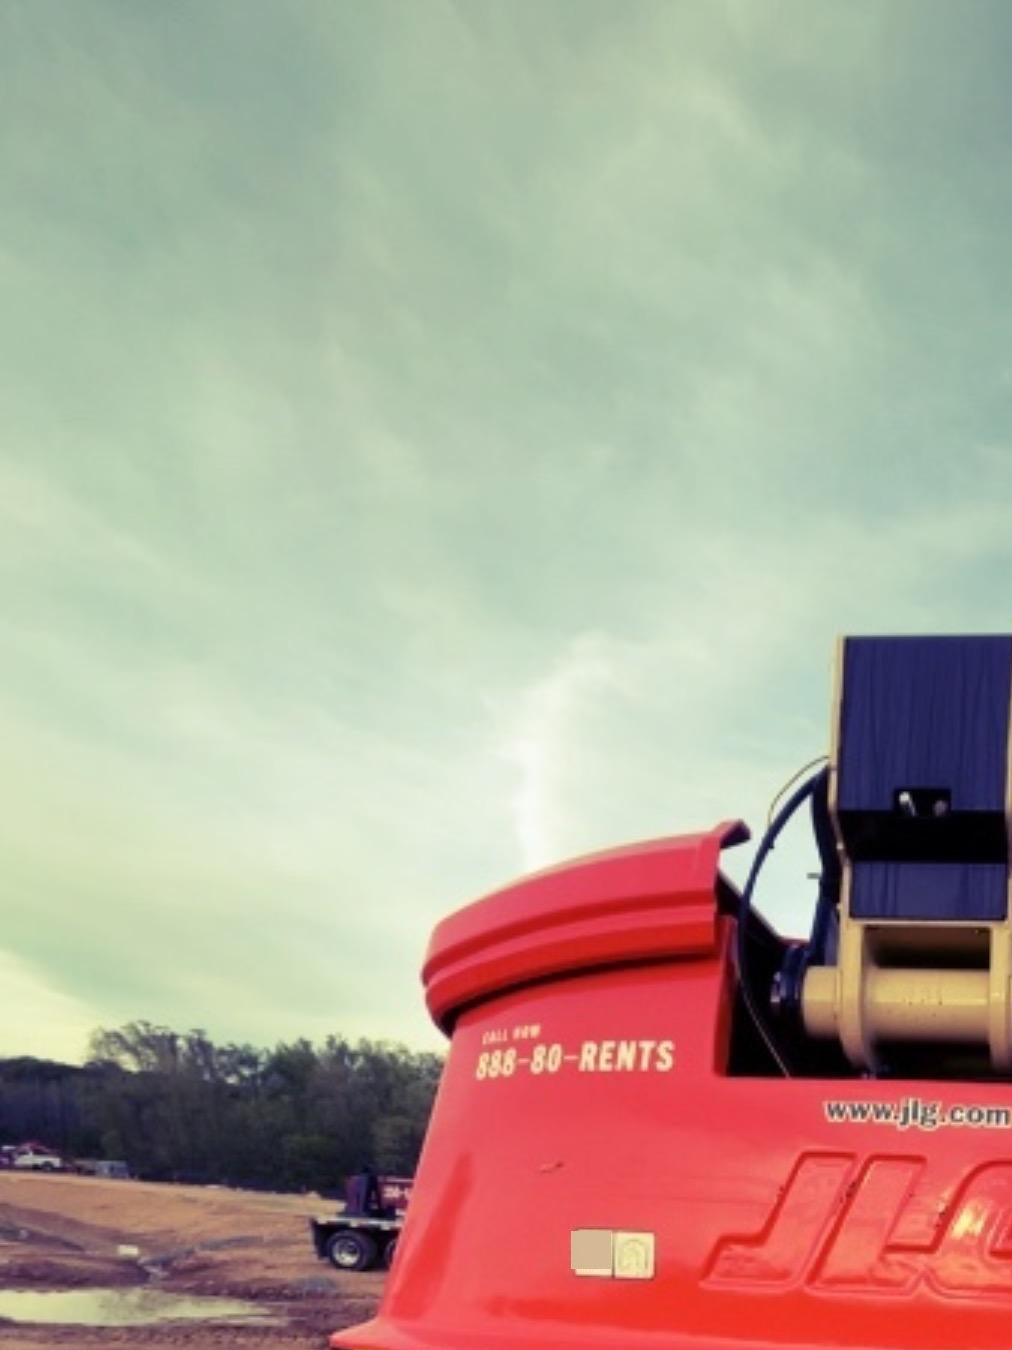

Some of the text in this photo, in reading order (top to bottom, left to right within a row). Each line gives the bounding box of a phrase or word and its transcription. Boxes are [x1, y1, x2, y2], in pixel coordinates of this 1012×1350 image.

[482, 1024, 541, 1045] CALL NOW
[475, 1039, 675, 1081] 888-80-RENTS
[824, 1098, 1012, 1131] www.jlg.com
